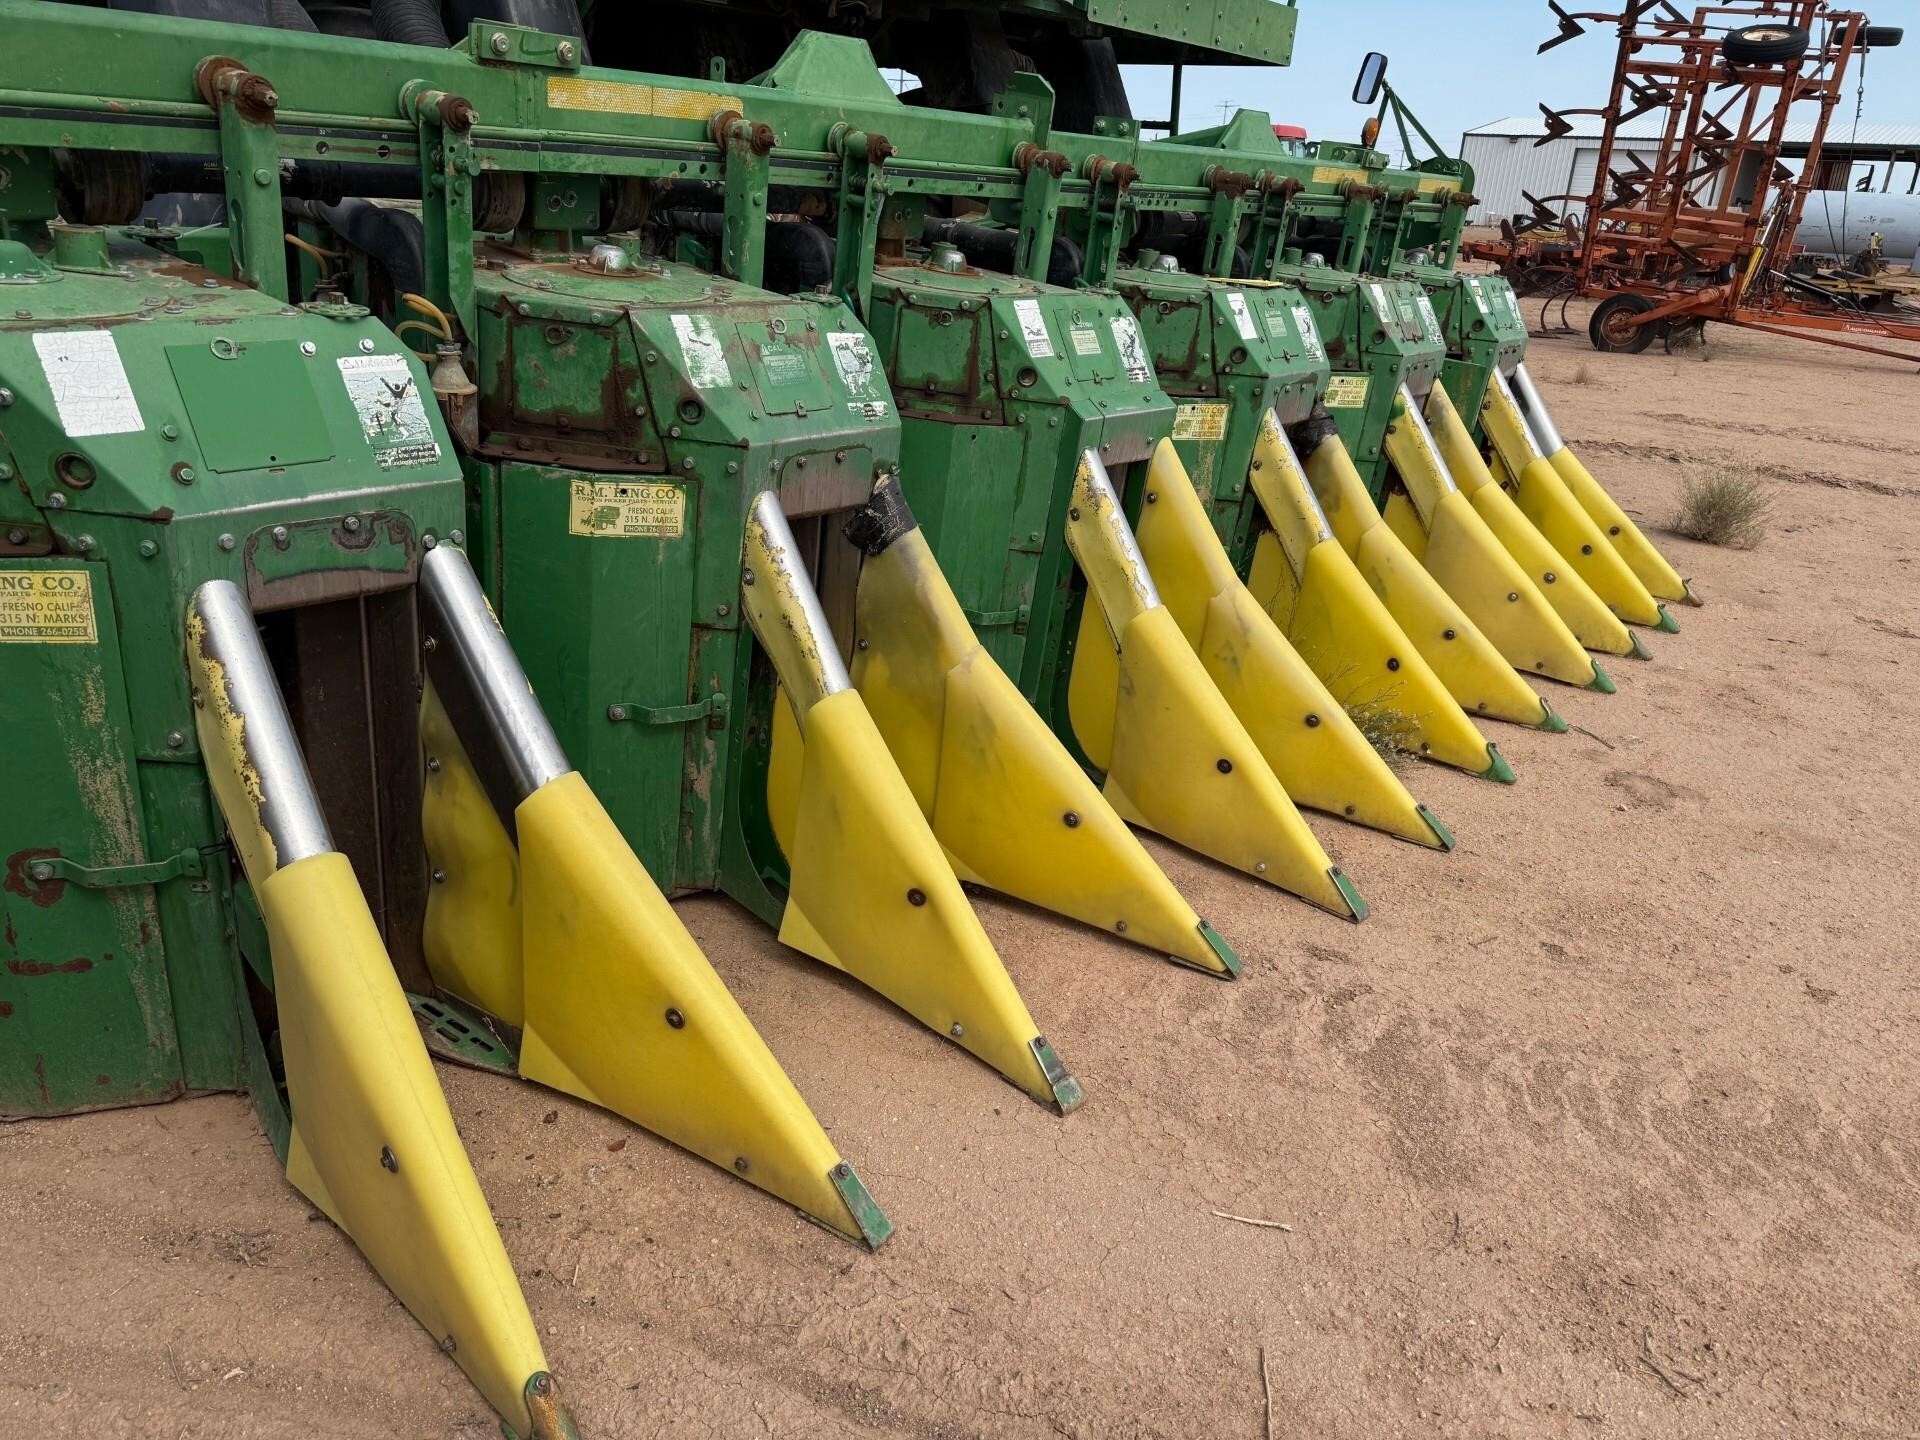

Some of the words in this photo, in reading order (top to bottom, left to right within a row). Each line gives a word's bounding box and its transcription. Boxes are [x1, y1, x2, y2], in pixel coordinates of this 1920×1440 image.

[655, 488, 680, 500] CO.
[628, 506, 654, 515] FRESNO
[624, 515, 639, 524] 315
[641, 515, 650, 524] N.
[652, 515, 679, 524] MARKS
[42, 576, 82, 590] CO.
[3, 602, 44, 612] FRESNO
[0, 613, 22, 624] 315
[26, 613, 40, 624] N.
[44, 613, 85, 624] MARKS
[4, 627, 39, 636] PHONE
